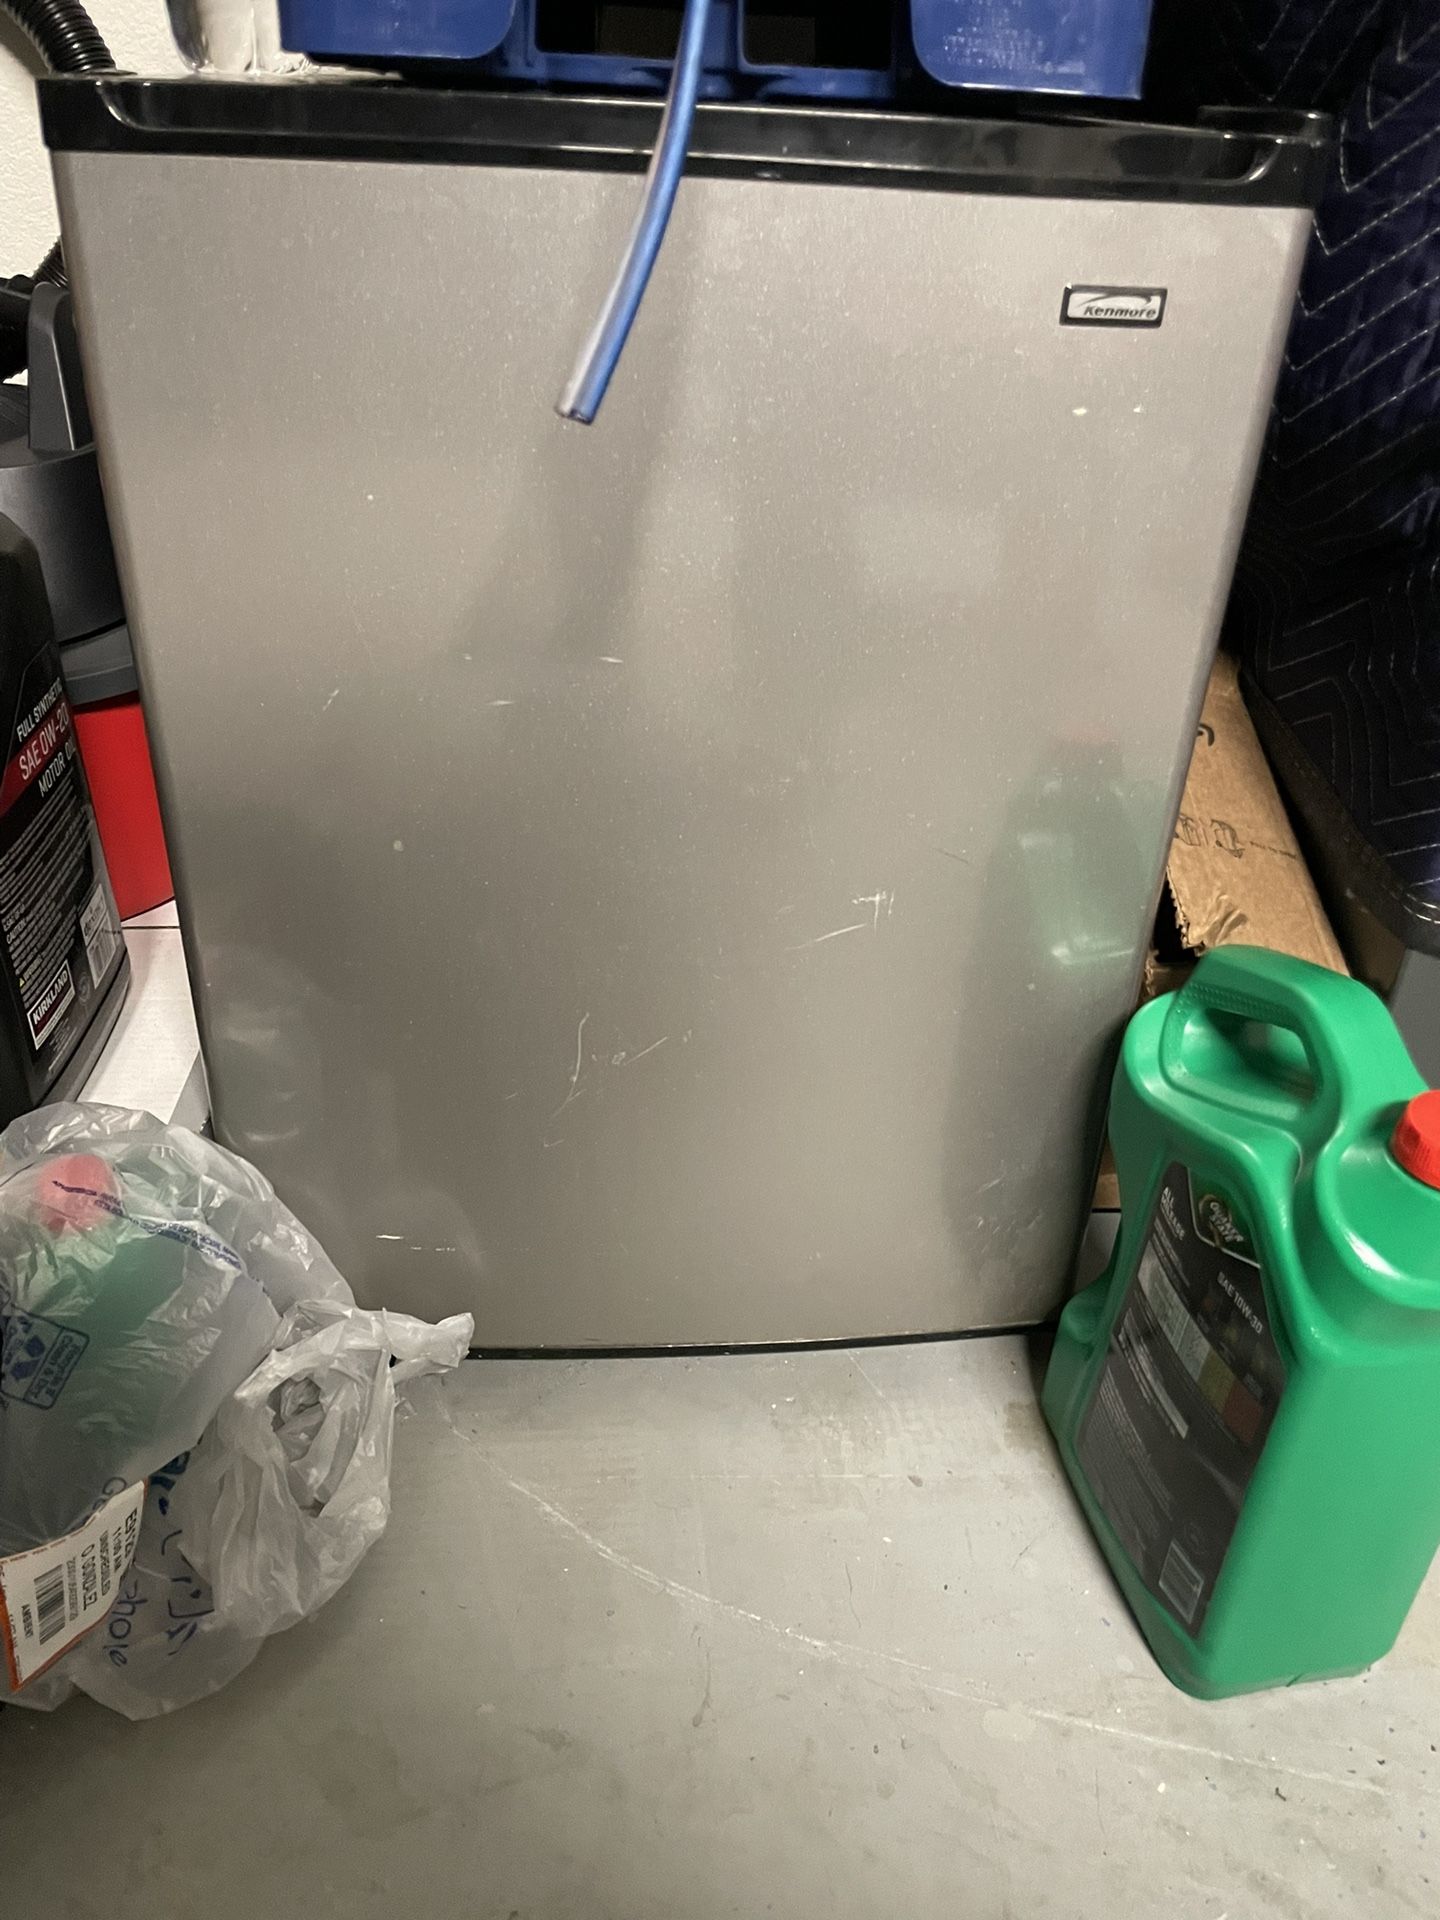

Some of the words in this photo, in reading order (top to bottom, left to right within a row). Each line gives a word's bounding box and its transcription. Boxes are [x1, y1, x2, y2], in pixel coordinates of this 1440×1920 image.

[1083, 305, 1157, 319] Kenmore
[16, 713, 36, 743] FULL
[19, 740, 42, 781] SAE
[39, 702, 70, 756] 0W-20
[38, 751, 66, 798] MOTOR
[32, 969, 69, 1025] KIRKLAND
[1217, 1271, 1235, 1297] SAE
[1233, 1292, 1264, 1334] 10W-30
[21, 1603, 34, 1640] AMBIENT
